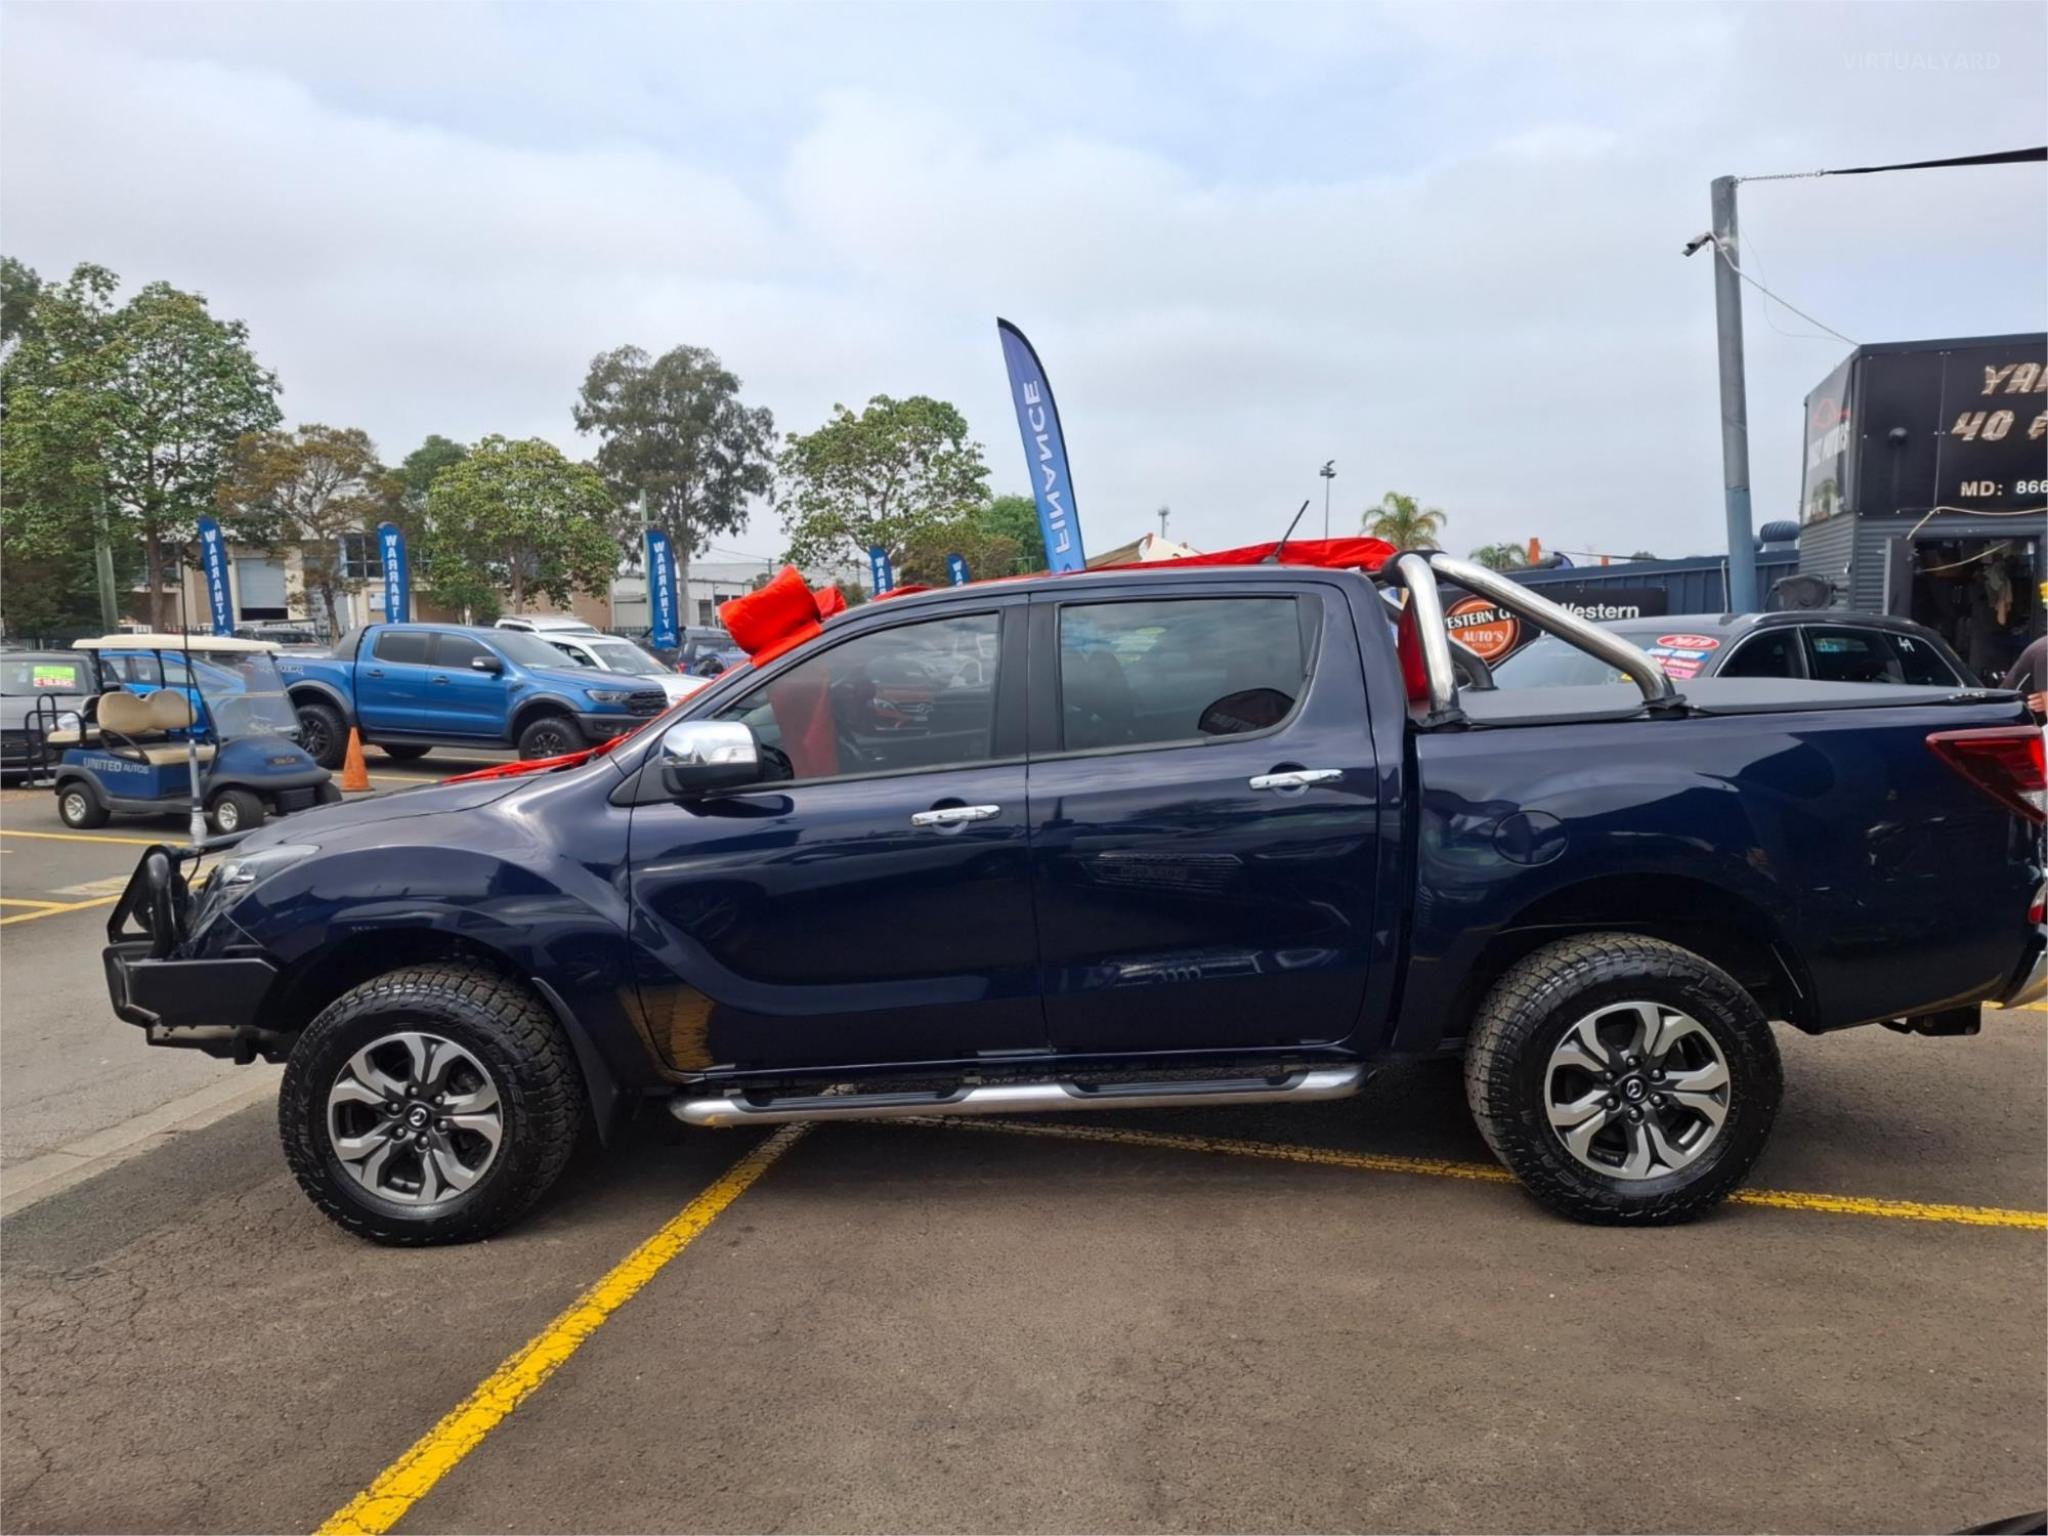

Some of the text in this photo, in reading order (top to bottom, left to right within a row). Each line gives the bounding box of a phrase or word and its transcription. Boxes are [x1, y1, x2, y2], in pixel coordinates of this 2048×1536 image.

[1951, 410, 2015, 441] 40
[1960, 480, 2003, 497] MD:
[204, 528, 226, 627] WARRANTY
[653, 541, 670, 629] WARRANTY
[1445, 610, 1495, 630] ESTERN
[1463, 630, 1505, 643] AUTO'S
[83, 757, 122, 772] UNITED
